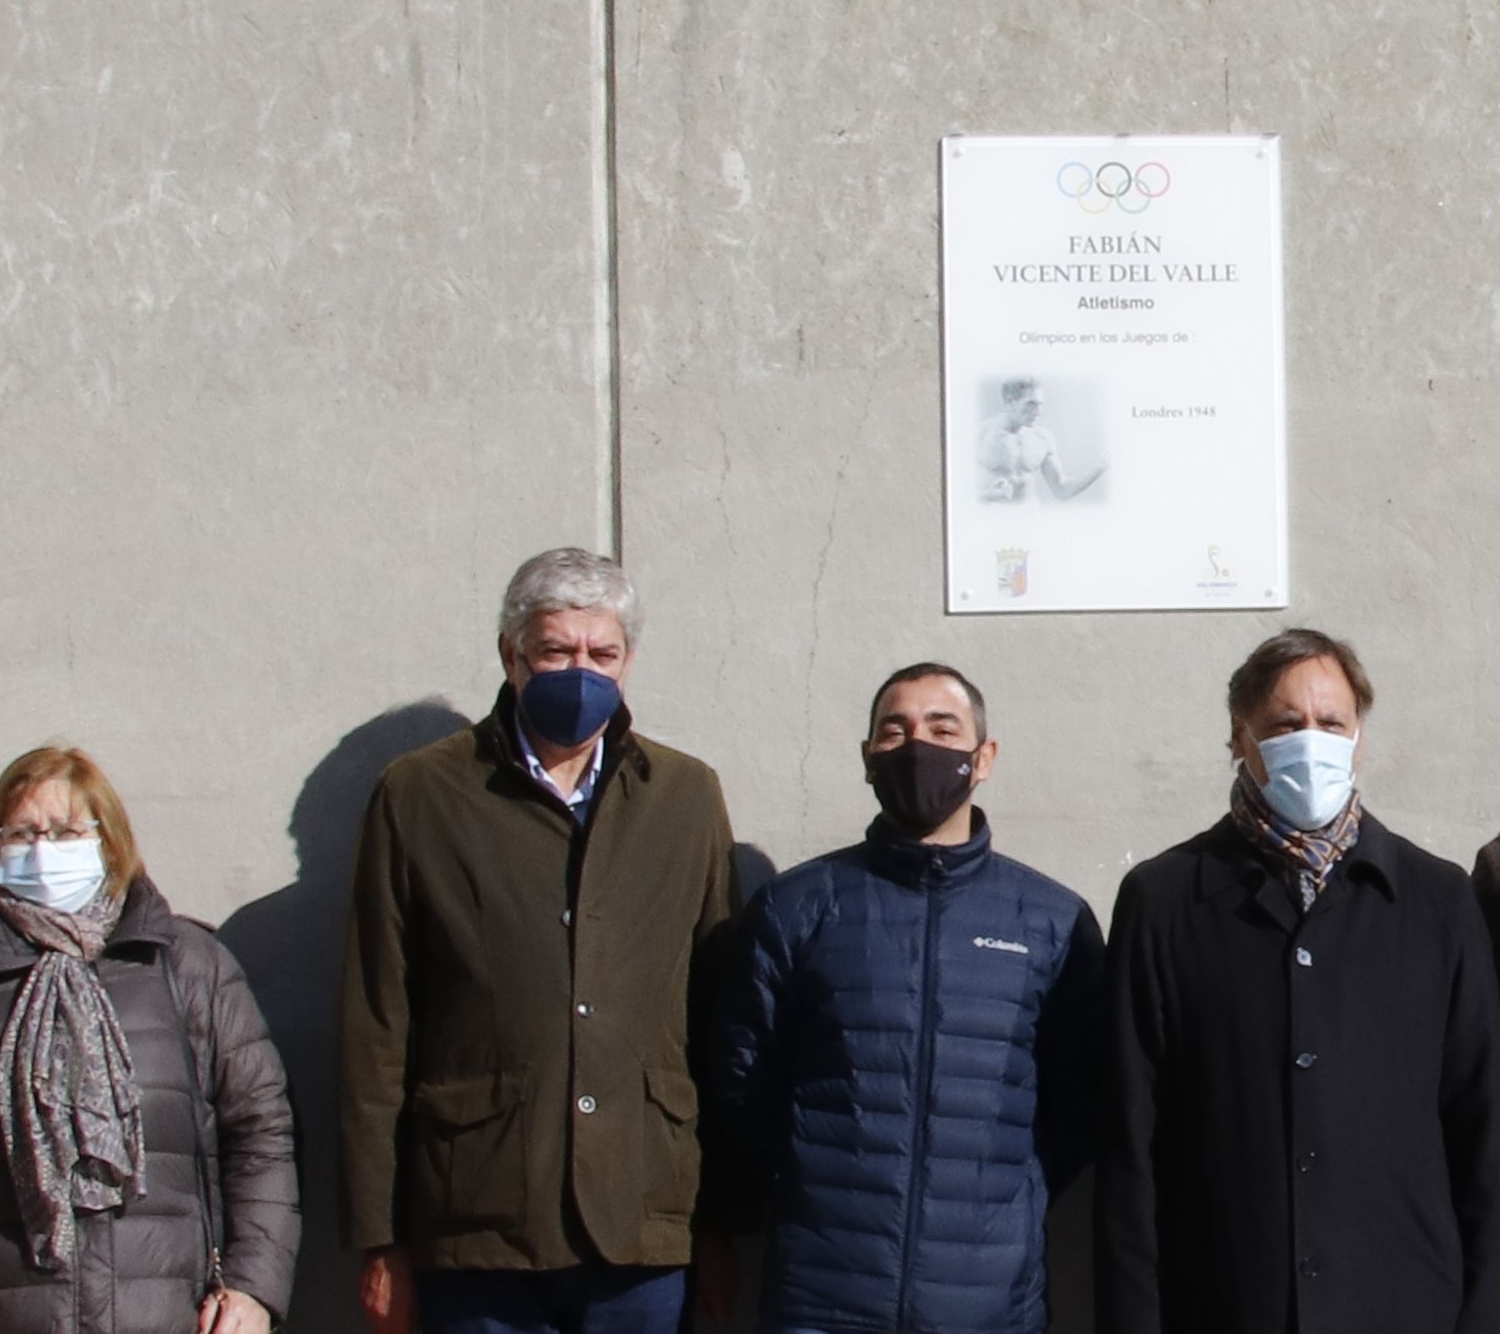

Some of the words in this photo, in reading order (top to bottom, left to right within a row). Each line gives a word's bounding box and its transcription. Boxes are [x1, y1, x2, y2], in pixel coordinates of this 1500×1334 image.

[1070, 231, 1160, 254] FABIÁN
[994, 264, 1102, 282] VICENTE
[1109, 264, 1155, 282] DEL
[1163, 264, 1238, 281] VALLE
[1077, 296, 1154, 309] Atletismo
[1080, 334, 1096, 344] en
[1099, 331, 1118, 343] los
[1122, 331, 1168, 346] Juegos
[1172, 332, 1188, 342] de
